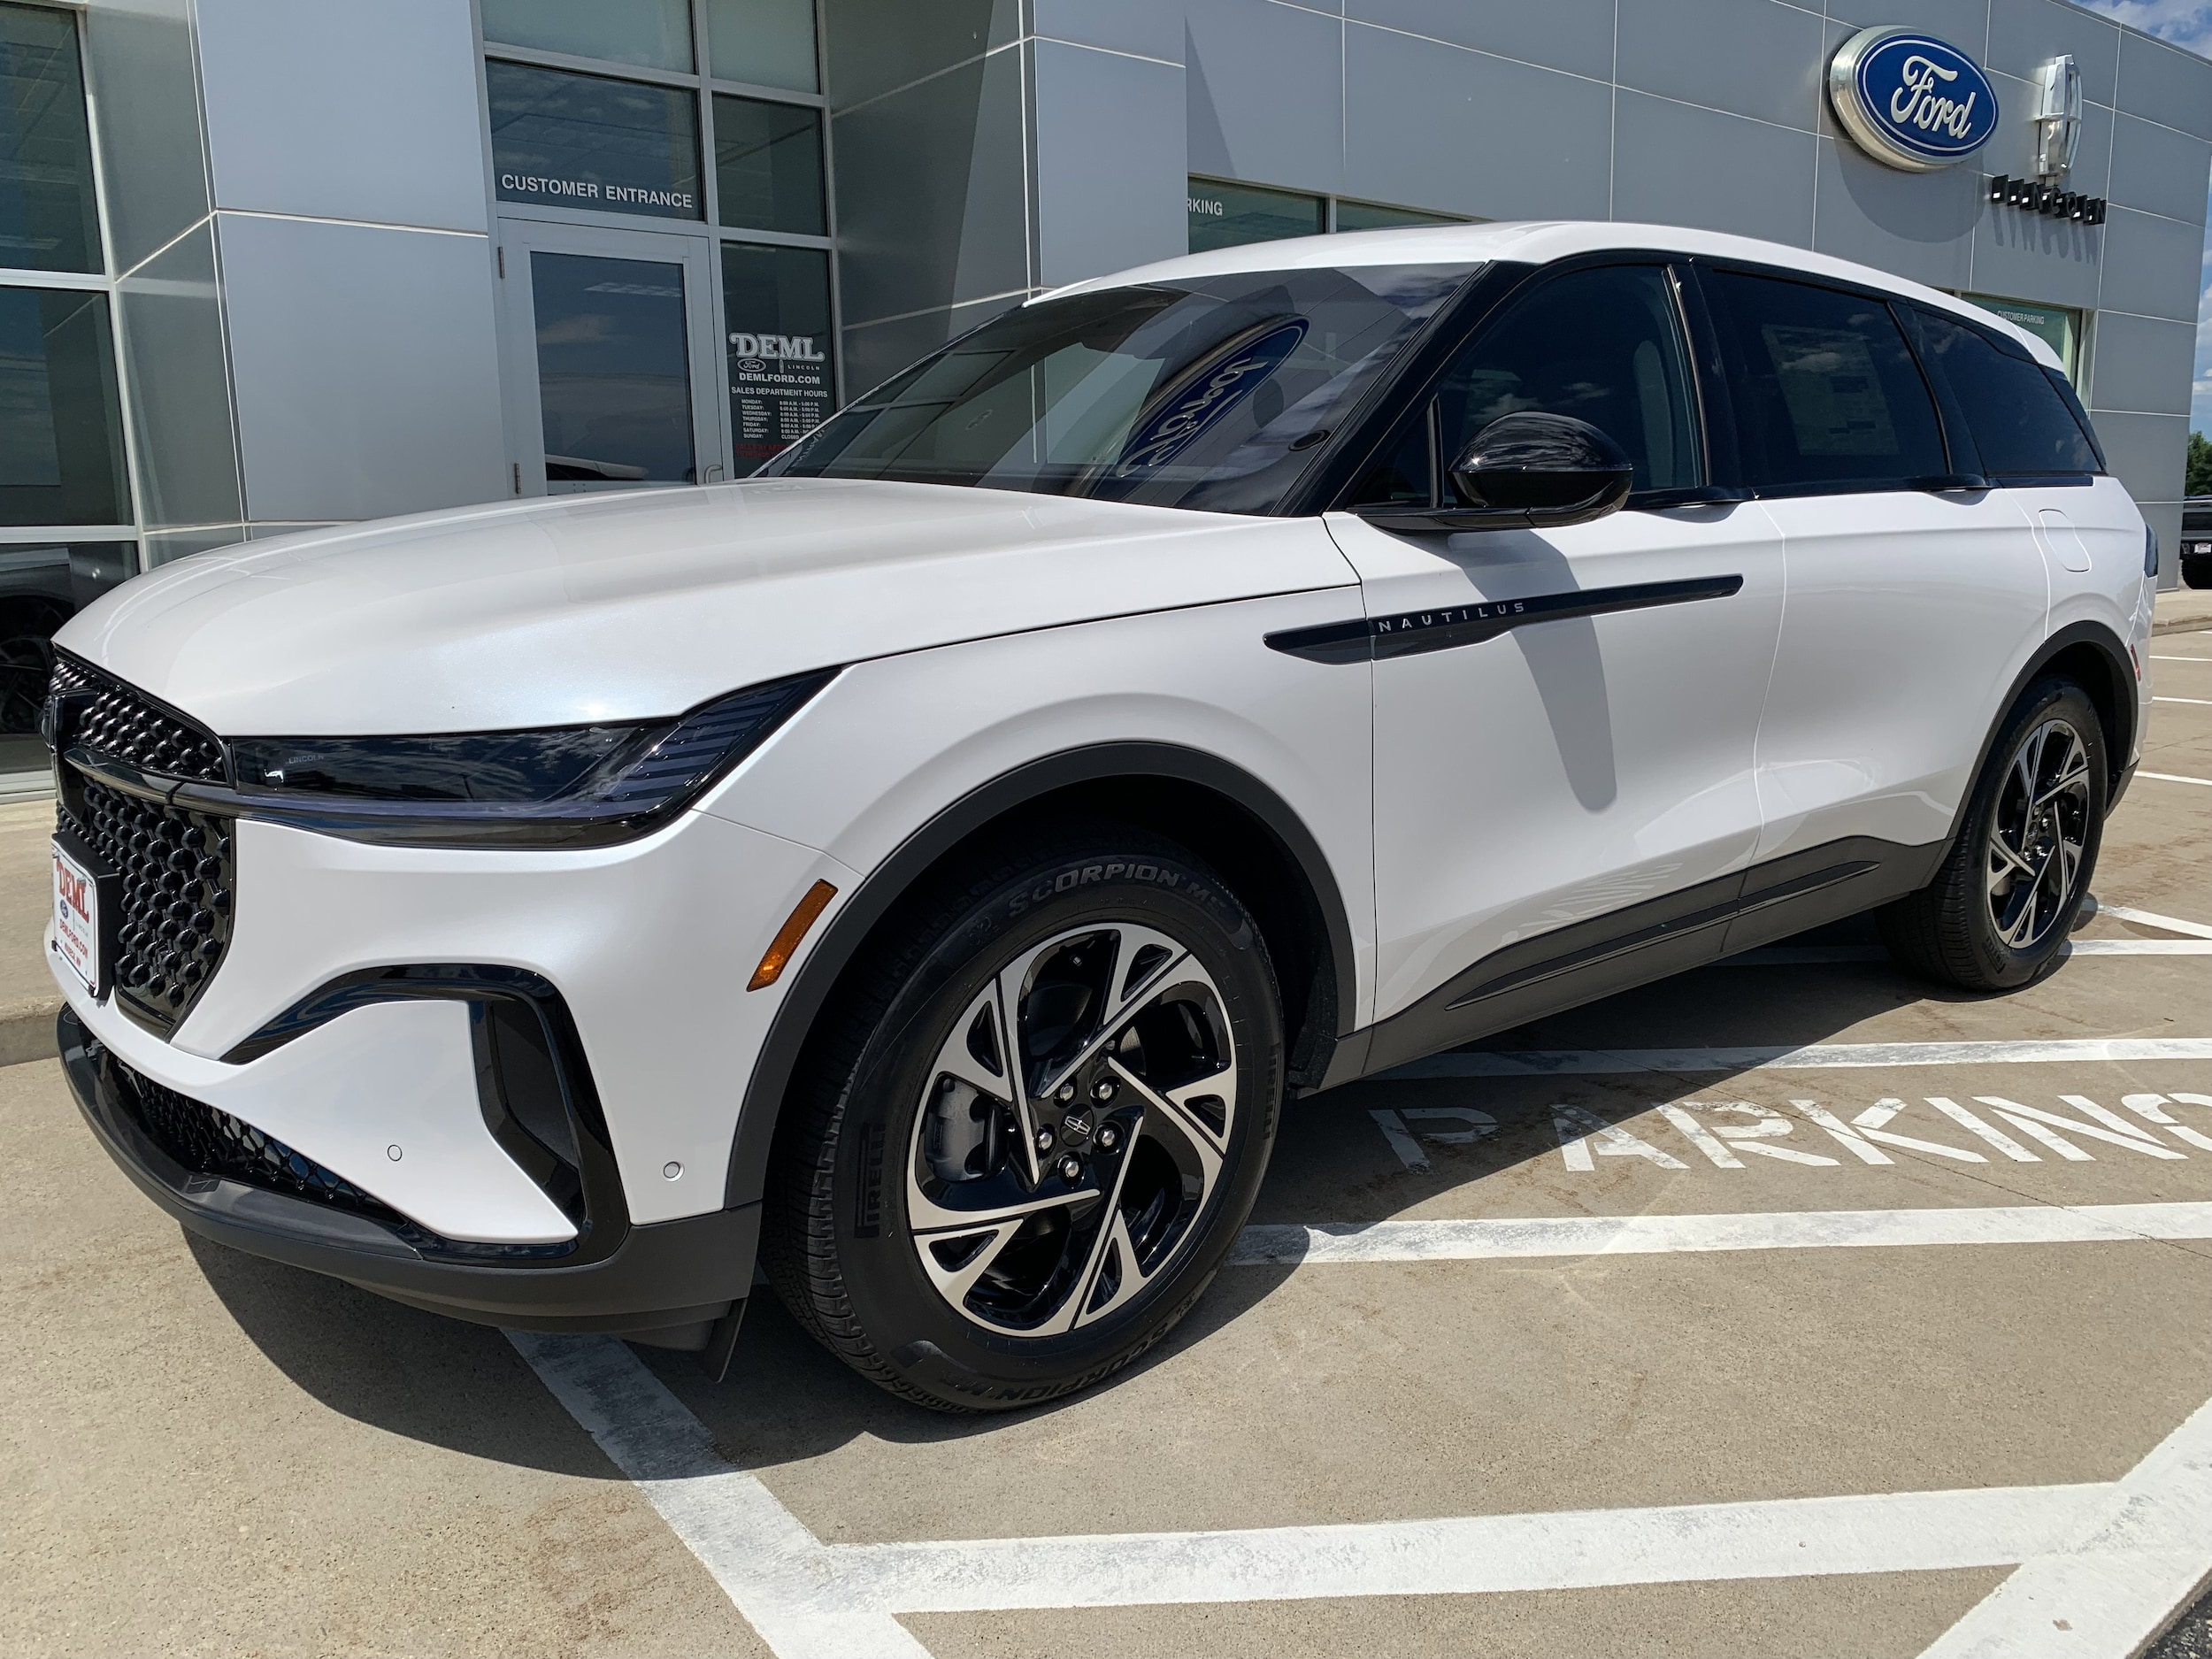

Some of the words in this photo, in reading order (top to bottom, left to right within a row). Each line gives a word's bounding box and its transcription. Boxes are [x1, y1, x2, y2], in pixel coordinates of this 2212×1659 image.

[1891, 56, 1976, 139] Ford
[502, 174, 598, 198] CUSTOMER
[606, 186, 693, 208] ENTRANCE
[1997, 311, 2024, 322] CUSTOMER
[2024, 313, 2044, 325] PARKING
[729, 333, 826, 362] DEML
[739, 373, 820, 384] DEMLFORD.COM
[756, 388, 803, 396] DEPARTMENT
[1379, 603, 1525, 633] NAUTILUS
[288, 755, 325, 764] LINCOLN
[57, 858, 89, 924] DEML
[1007, 863, 1180, 918] SCORPION
